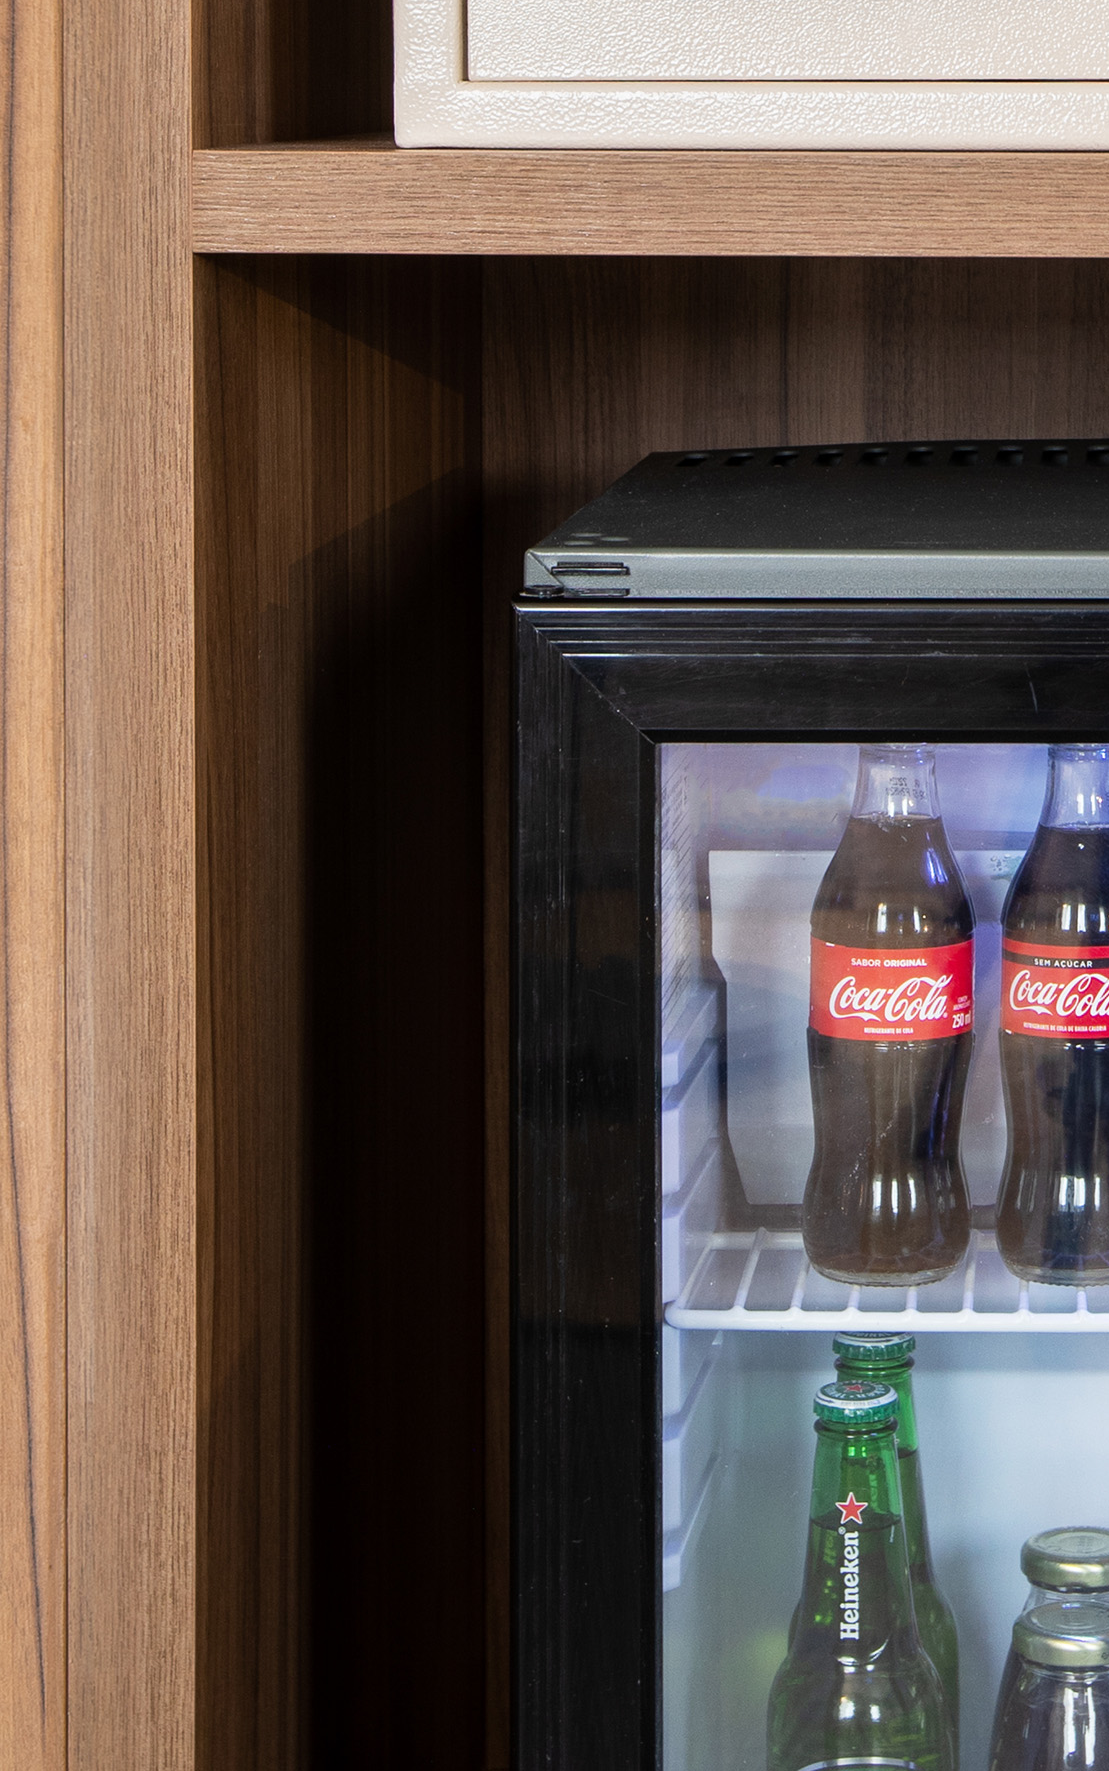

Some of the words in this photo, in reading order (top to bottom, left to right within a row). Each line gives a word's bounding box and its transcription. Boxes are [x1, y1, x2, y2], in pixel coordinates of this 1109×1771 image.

[851, 958, 881, 967] SABOR
[883, 958, 927, 967] ORIGINAL
[1034, 958, 1051, 968] SEM
[1054, 957, 1093, 969] AÇÚCAR
[829, 974, 953, 1022] Coca-Cola
[952, 1013, 965, 1029] 250
[840, 1531, 859, 1640] Heineken
